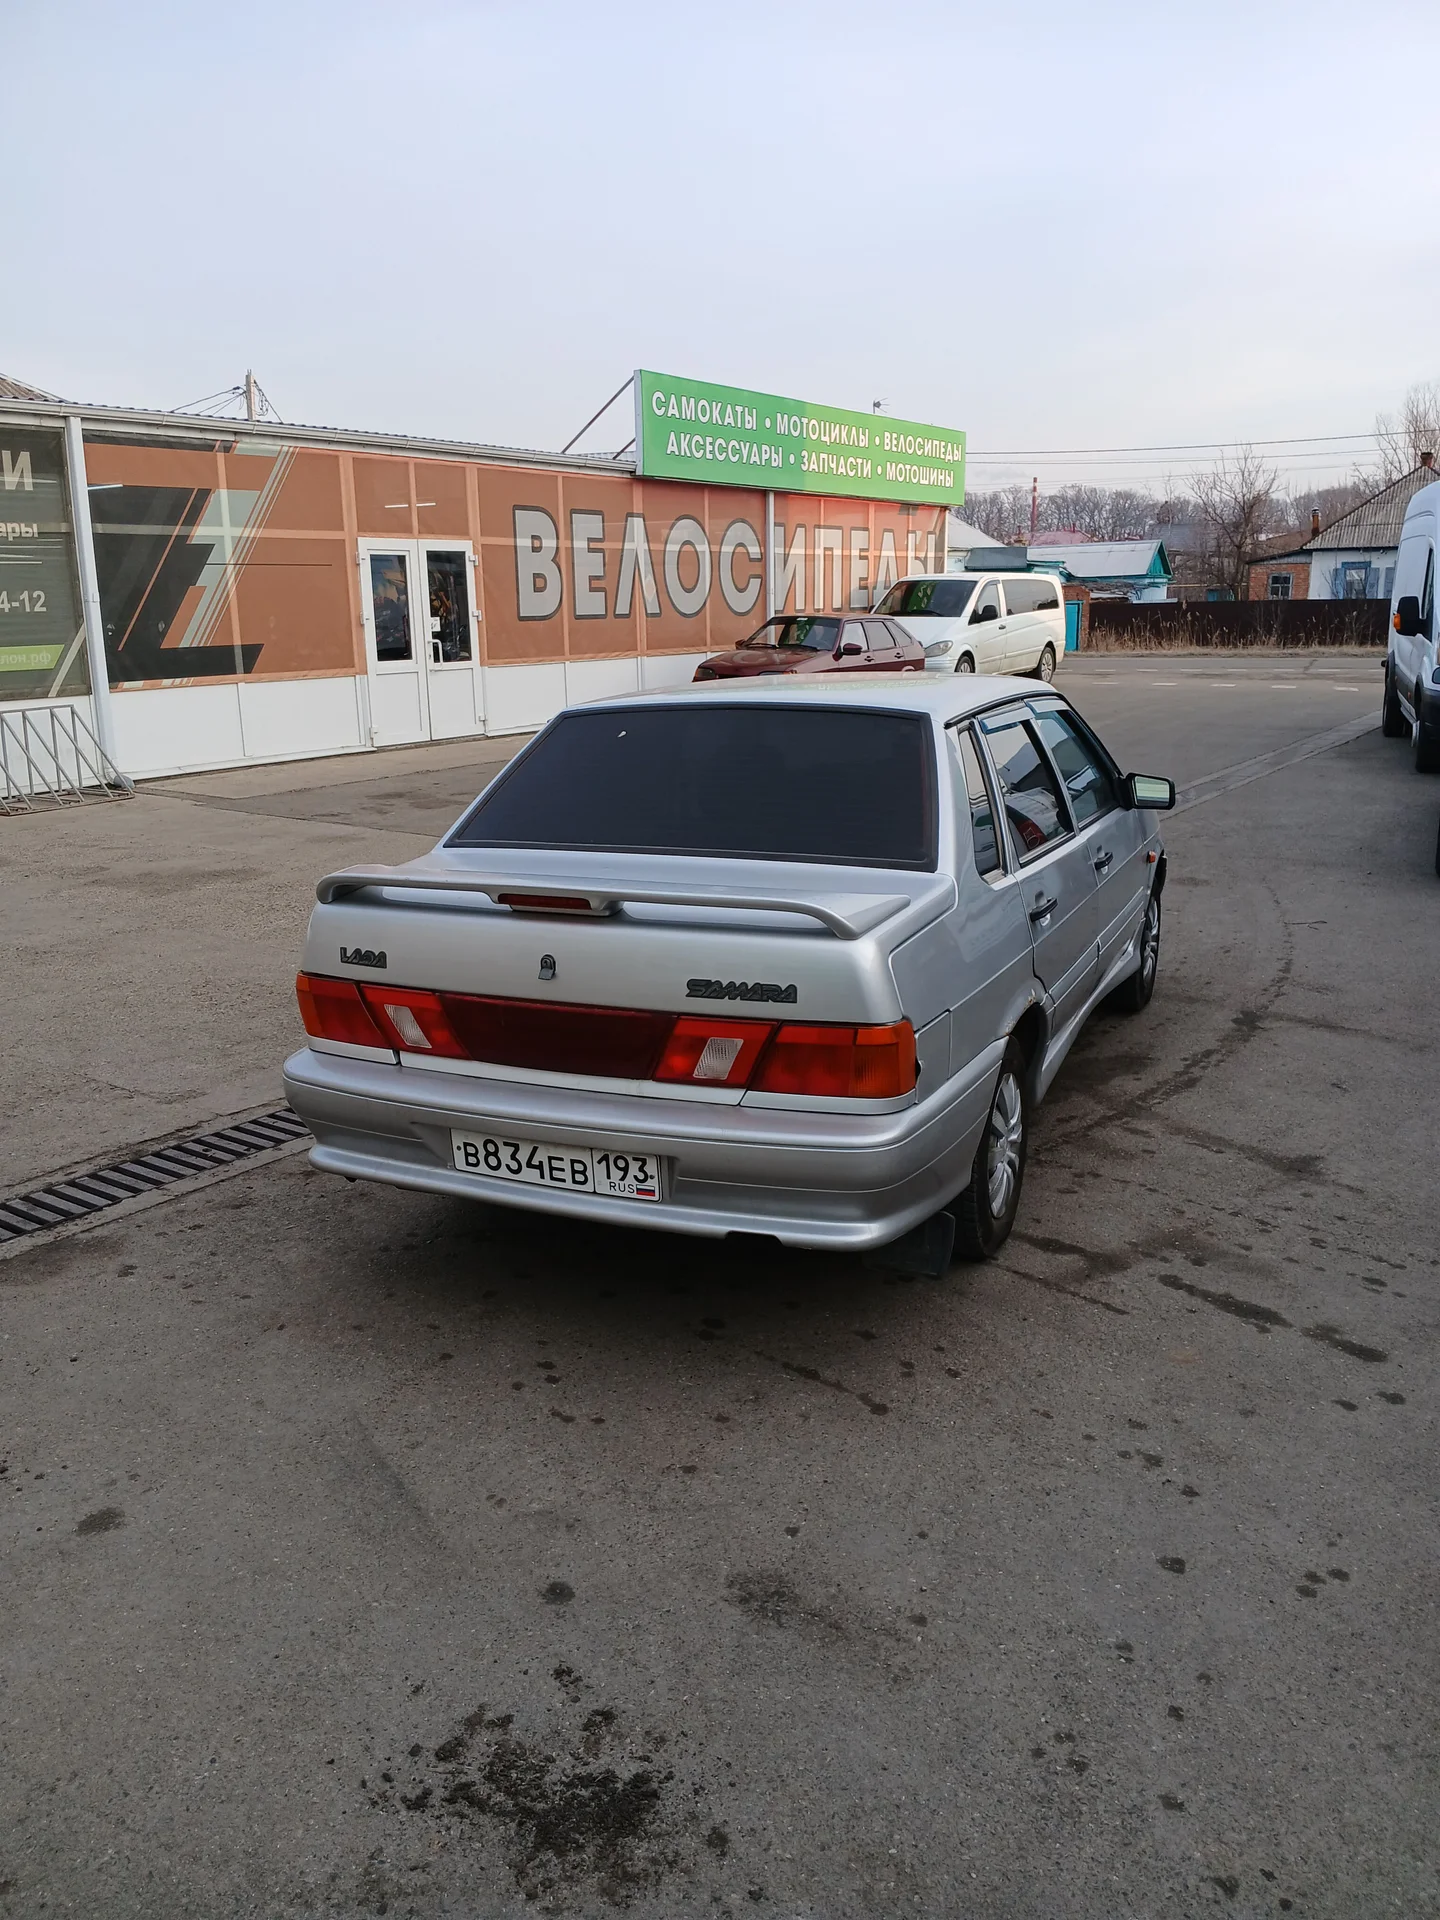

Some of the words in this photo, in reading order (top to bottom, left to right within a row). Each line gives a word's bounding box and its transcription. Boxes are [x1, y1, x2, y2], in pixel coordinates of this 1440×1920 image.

[652, 390, 757, 430] САМОКАТЫ
[776, 412, 869, 448] МОТОЦИКЛЫ
[884, 430, 962, 464] ВЕЛОСИПЕДЫ
[666, 431, 782, 468] АКСЕССУАРЫ
[800, 450, 871, 478] ЗАПЧАСТИ
[886, 462, 954, 488] МОТОШИНЫ
[340, 947, 387, 969] LADA
[685, 979, 797, 1003] SAMARA
[597, 1153, 649, 1184] 193
[609, 1181, 635, 1194] RUS
